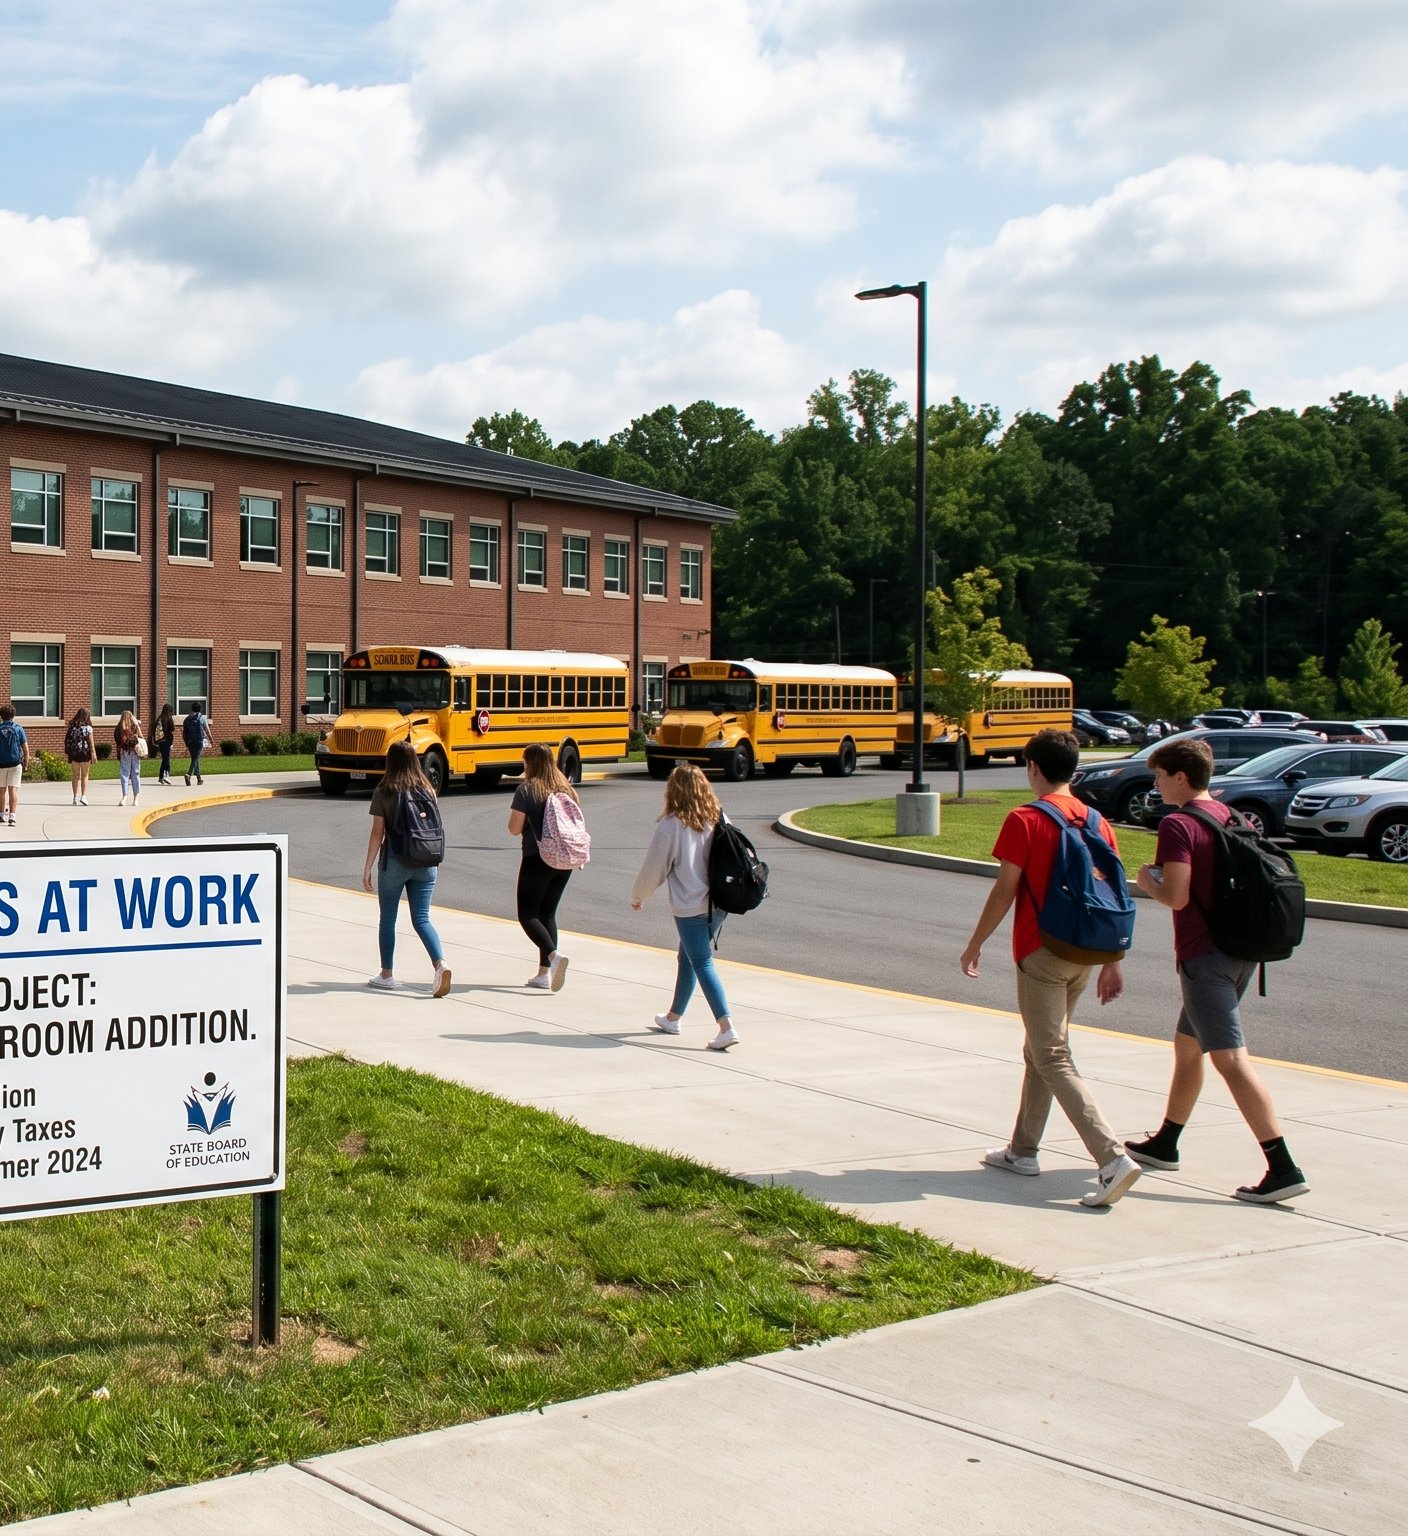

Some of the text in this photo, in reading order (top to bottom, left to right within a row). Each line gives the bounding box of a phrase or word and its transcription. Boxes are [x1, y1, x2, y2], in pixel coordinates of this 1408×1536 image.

[38, 880, 98, 934] AT
[114, 873, 261, 929] WORK
[104, 1008, 258, 1052] ADDITION.
[12, 1119, 76, 1143] Taxes
[169, 1138, 247, 1155] STATE BOARD
[47, 1146, 103, 1175] 2024
[166, 1151, 250, 1169] OF EDUCATION
